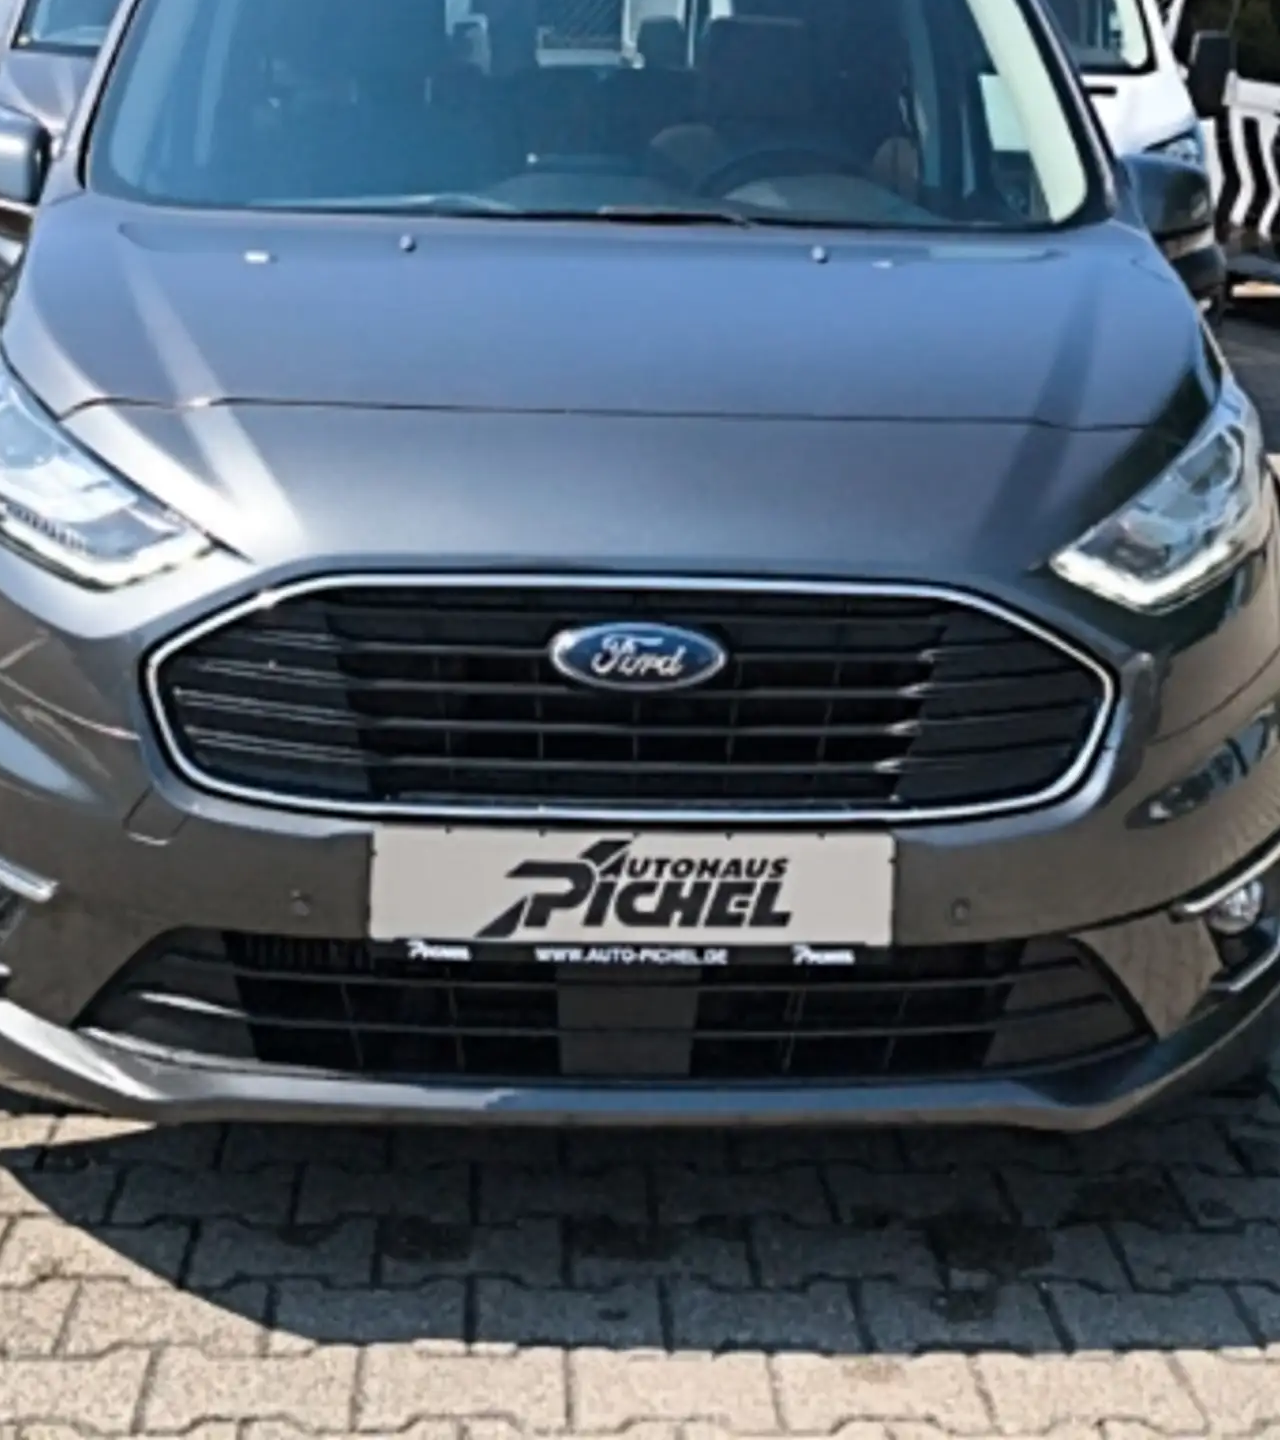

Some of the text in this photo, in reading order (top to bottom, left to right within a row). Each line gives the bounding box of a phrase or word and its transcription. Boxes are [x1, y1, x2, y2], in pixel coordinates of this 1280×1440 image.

[590, 633, 688, 678] Ford
[588, 844, 788, 879] AUTOHAUS
[504, 861, 792, 928] PICHEL
